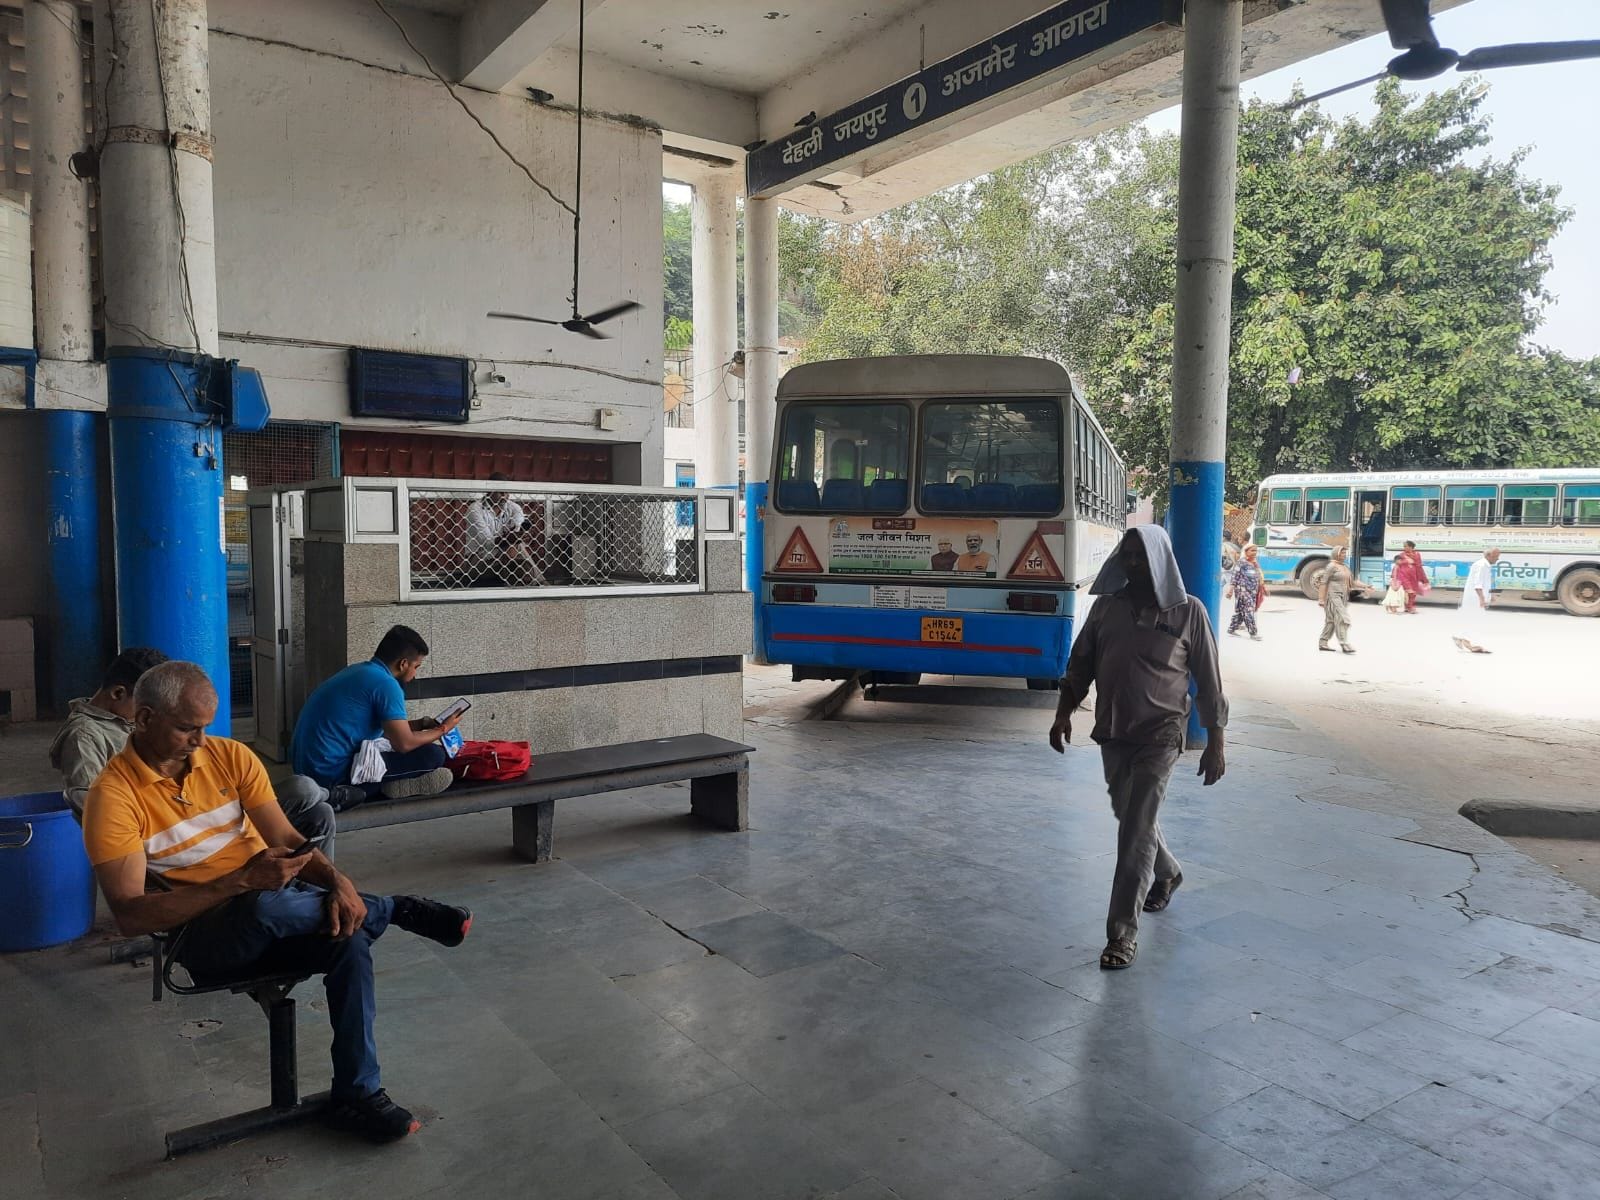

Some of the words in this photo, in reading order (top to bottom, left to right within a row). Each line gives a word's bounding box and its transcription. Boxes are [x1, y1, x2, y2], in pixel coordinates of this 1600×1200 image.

[782, 126, 823, 164] देहली
[833, 103, 888, 141] जयपुर
[941, 43, 1018, 96] अजमेर
[1029, 1, 1110, 57] आगरा
[856, 533, 874, 541] जल
[877, 531, 903, 542] जीवन
[905, 531, 932, 543] मिशन
[1494, 561, 1550, 579] तिरंगा
[932, 619, 955, 629] HR69
[929, 630, 957, 640] C1544
